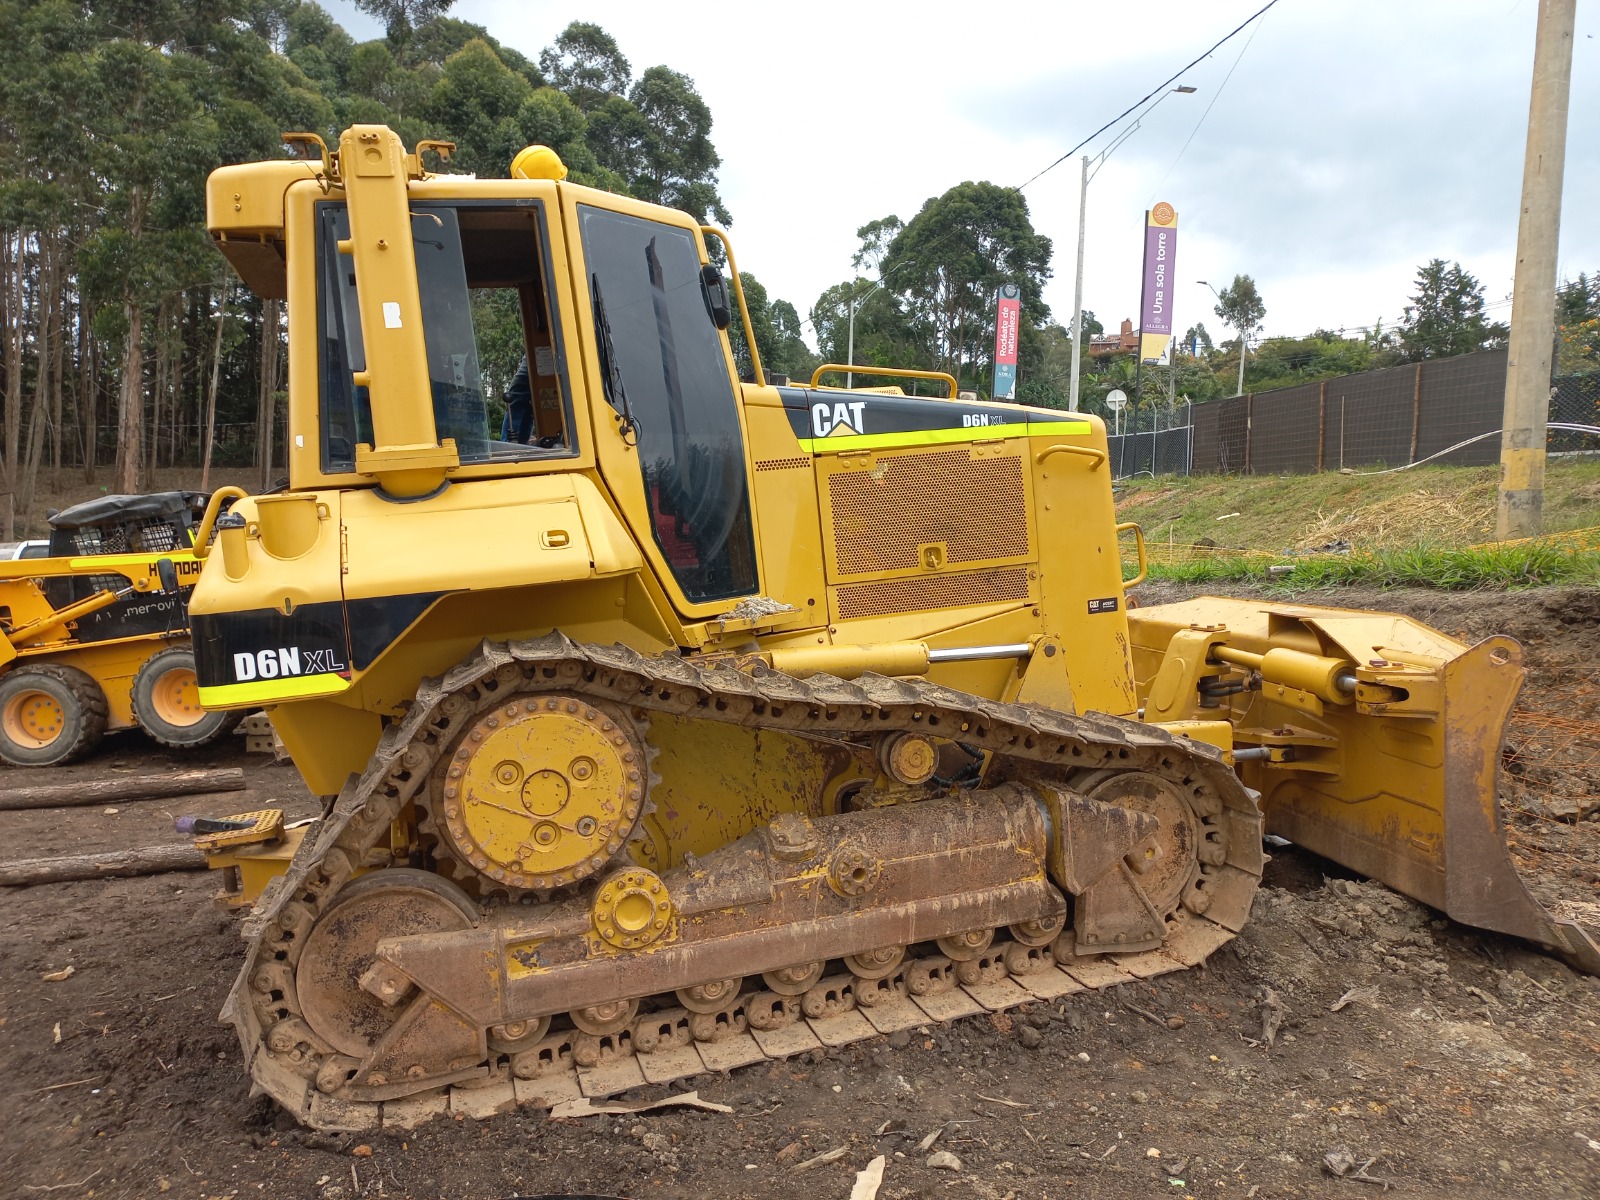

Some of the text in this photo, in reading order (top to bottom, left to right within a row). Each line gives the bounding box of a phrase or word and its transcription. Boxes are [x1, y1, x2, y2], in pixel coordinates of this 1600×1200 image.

[1152, 232, 1167, 314] Una sola torre
[1001, 306, 1009, 318] de
[1007, 310, 1016, 355] naturaleza
[812, 401, 865, 437] CAT
[962, 413, 1007, 428] D6N XL
[148, 560, 203, 577] HNDAI
[1089, 600, 1100, 609] CAT
[233, 646, 345, 682] D6N XL
